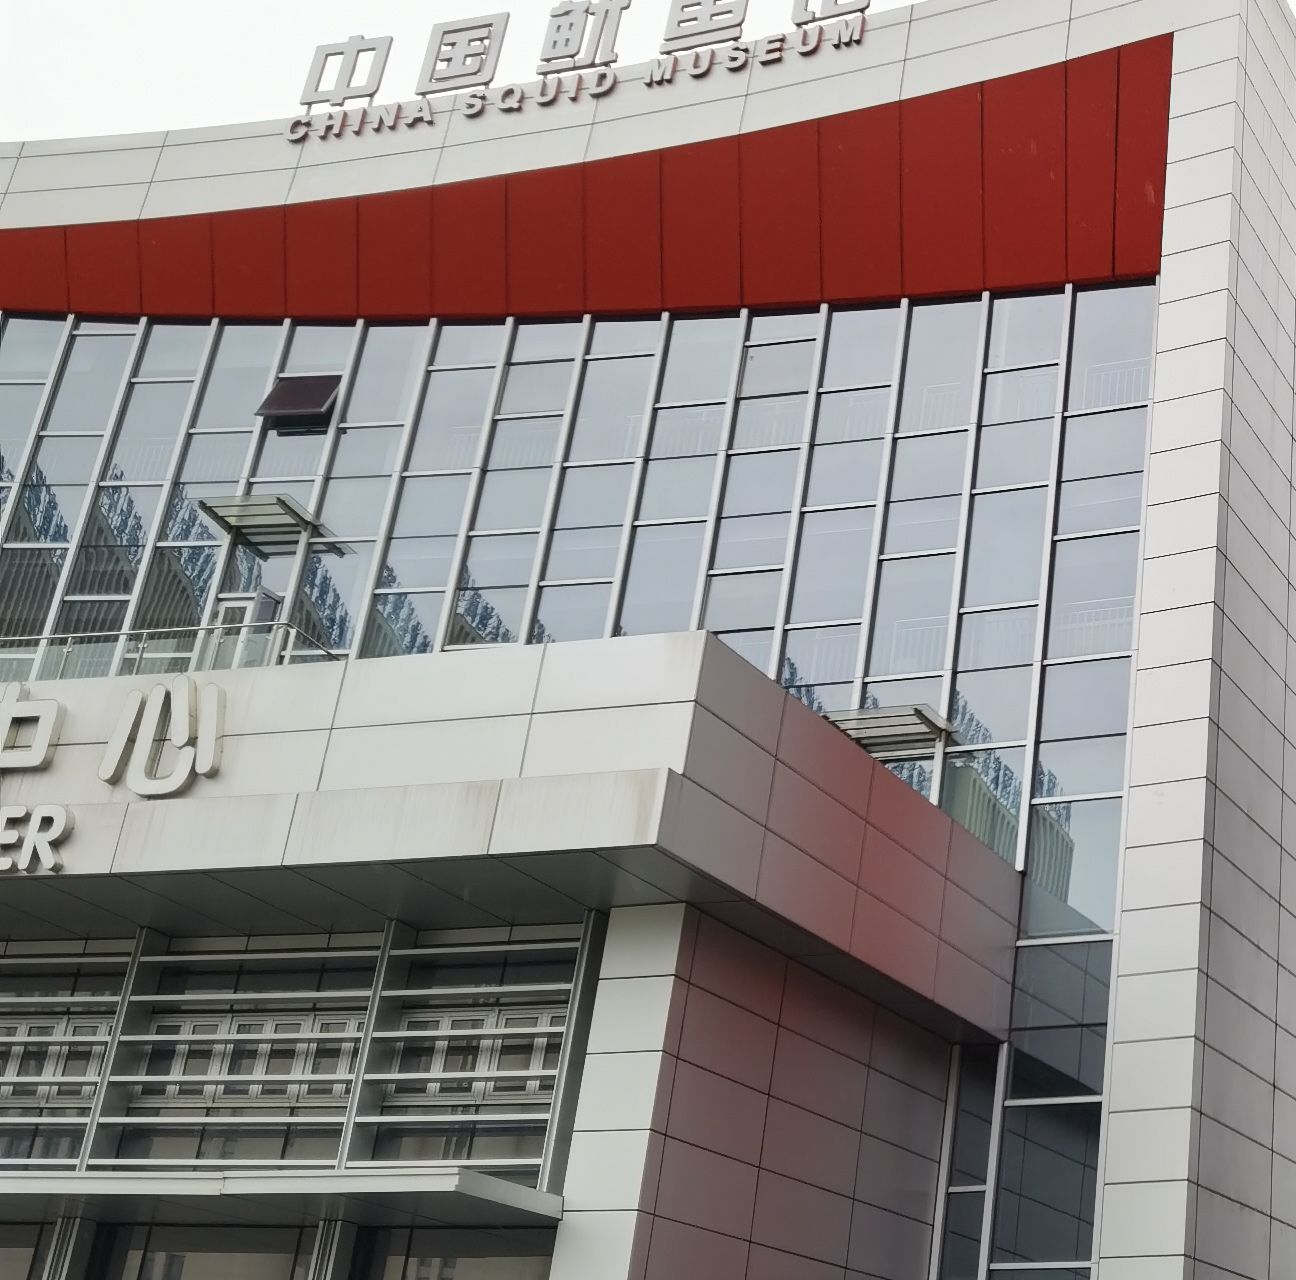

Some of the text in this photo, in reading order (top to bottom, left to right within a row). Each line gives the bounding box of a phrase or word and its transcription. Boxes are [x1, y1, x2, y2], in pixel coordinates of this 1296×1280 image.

[286, 13, 866, 143] CHINA SQUID MUSEUM
